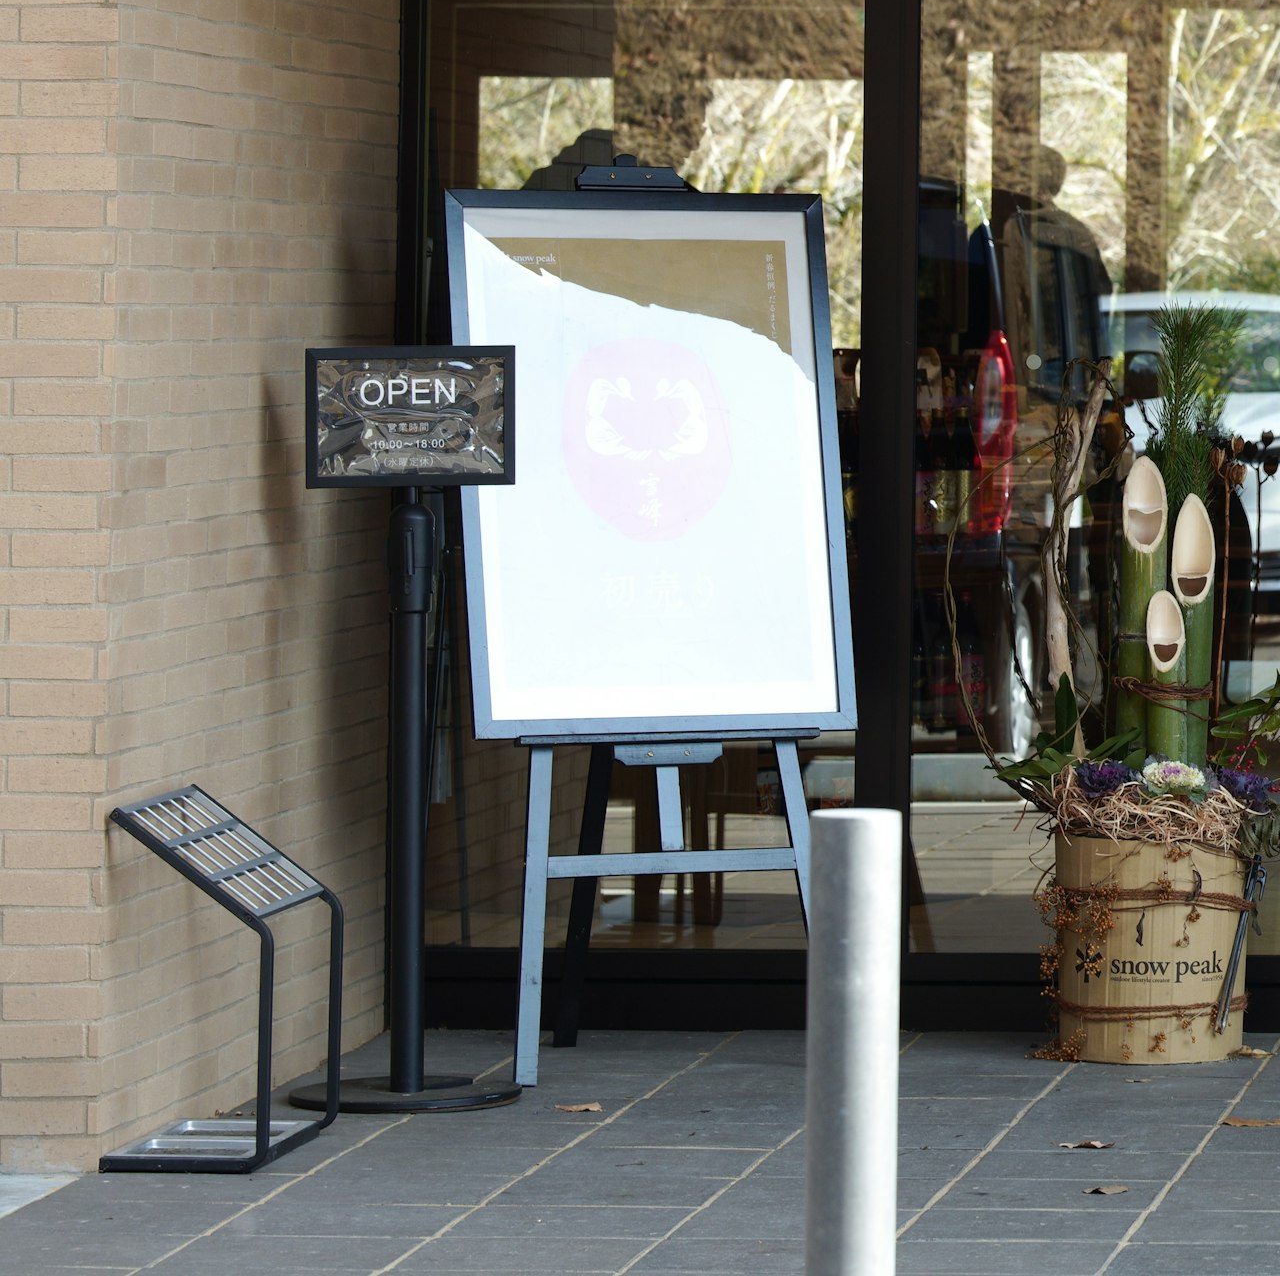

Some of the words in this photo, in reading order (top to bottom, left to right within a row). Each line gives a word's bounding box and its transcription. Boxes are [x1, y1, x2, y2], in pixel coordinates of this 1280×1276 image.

[536, 253, 556, 265] peak
[359, 377, 457, 406] OPEN
[386, 422, 430, 433] 営業時間
[1110, 957, 1172, 976] snow
[1174, 949, 1224, 983] peak
